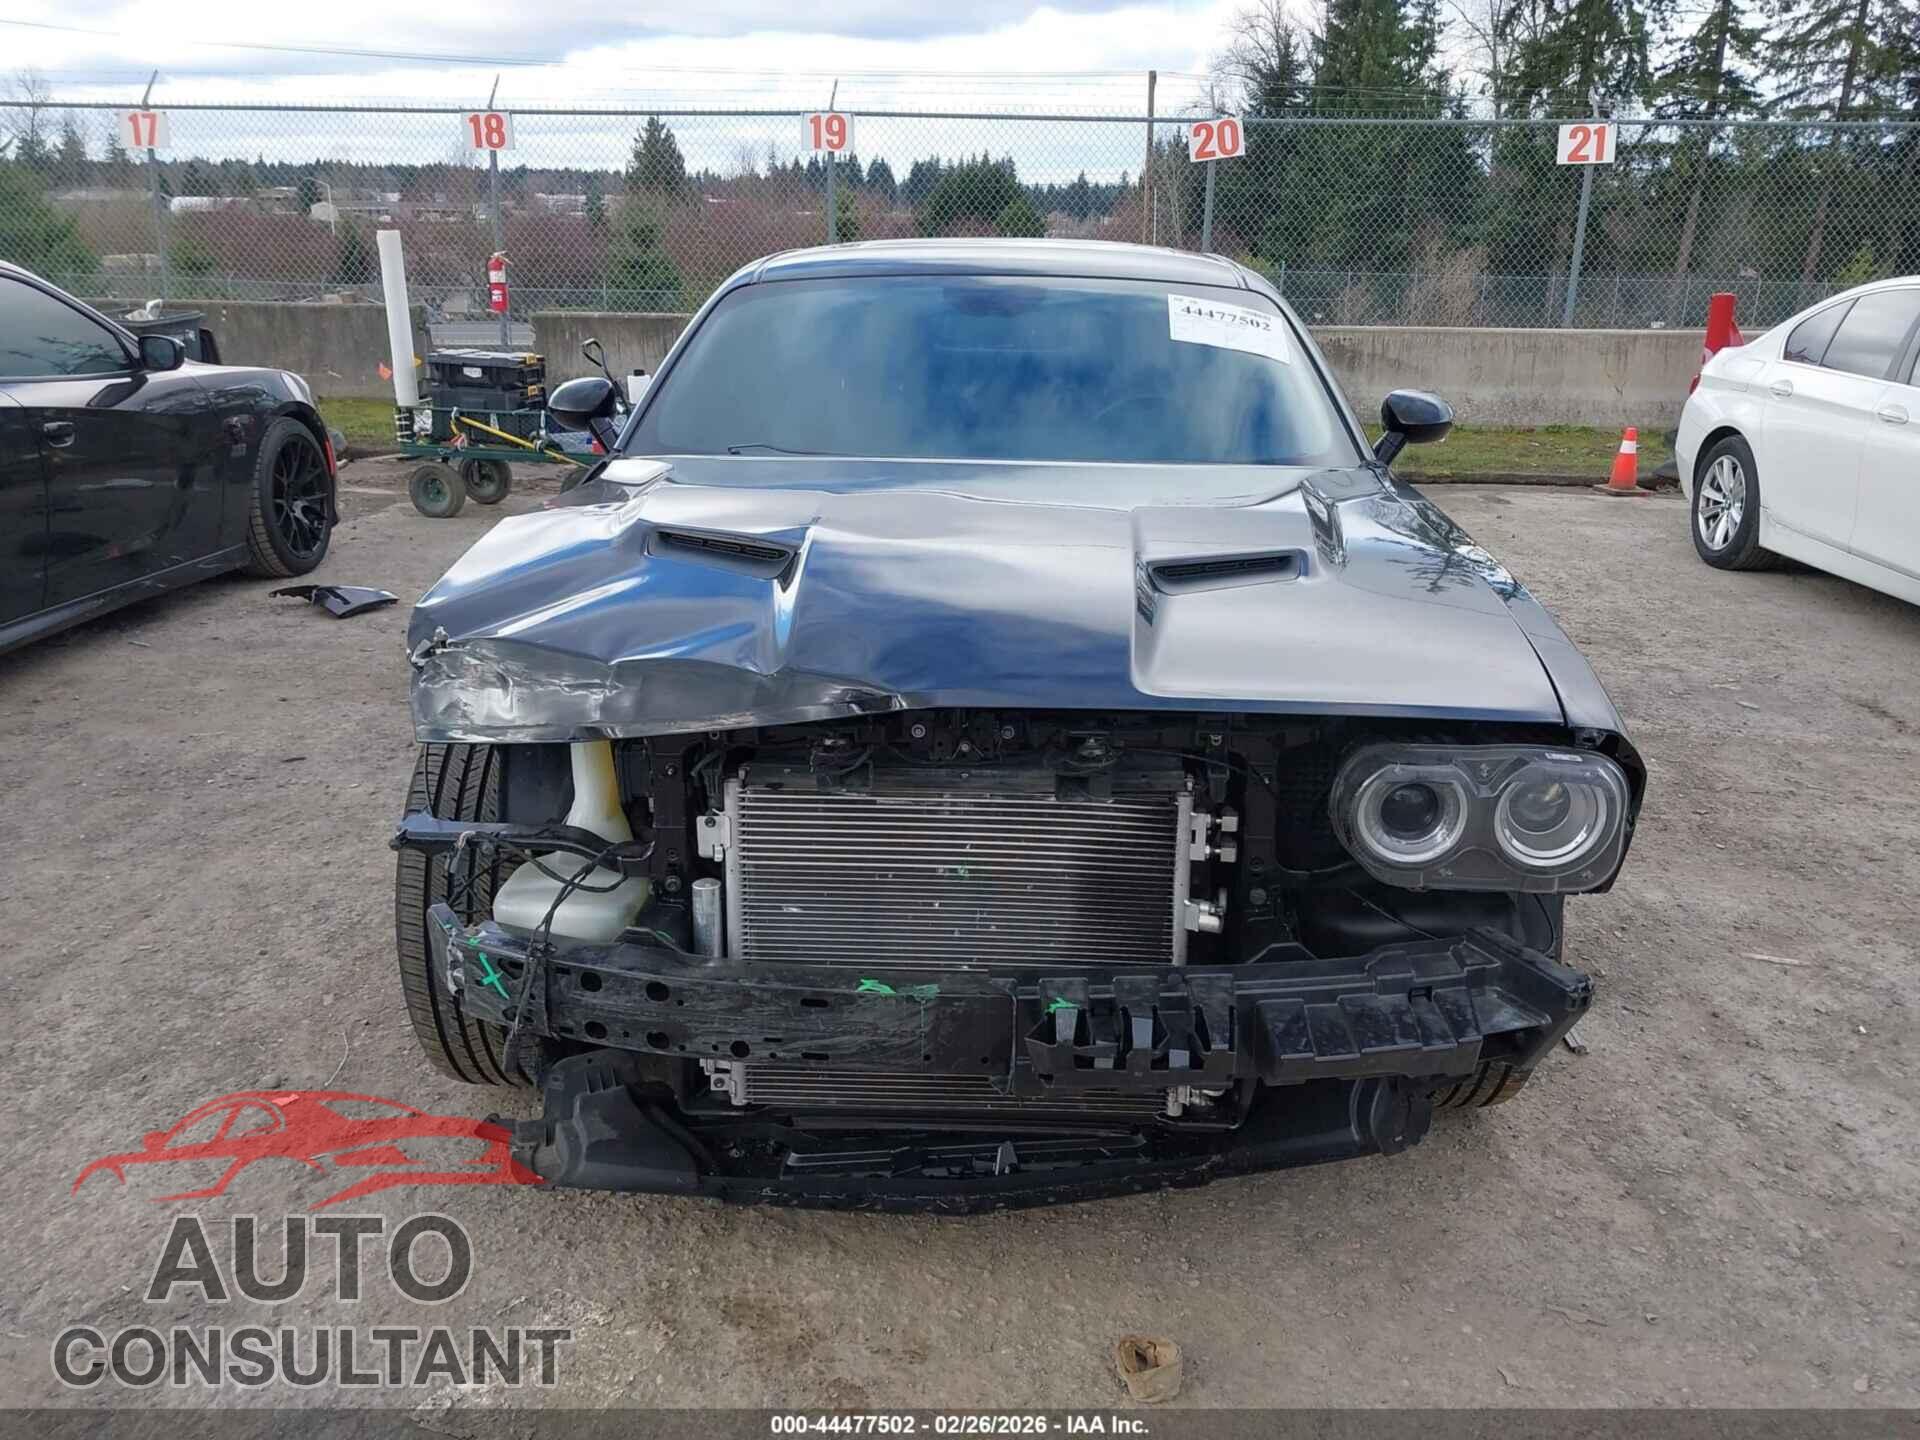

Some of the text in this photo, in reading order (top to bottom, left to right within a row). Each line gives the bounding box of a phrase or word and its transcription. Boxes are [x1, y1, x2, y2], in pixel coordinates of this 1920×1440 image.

[127, 112, 158, 148] 17
[468, 112, 507, 150] 18
[809, 114, 847, 151] 19
[1193, 119, 1240, 160] 20
[1567, 125, 1607, 162] 21
[1181, 305, 1272, 332] 44477502
